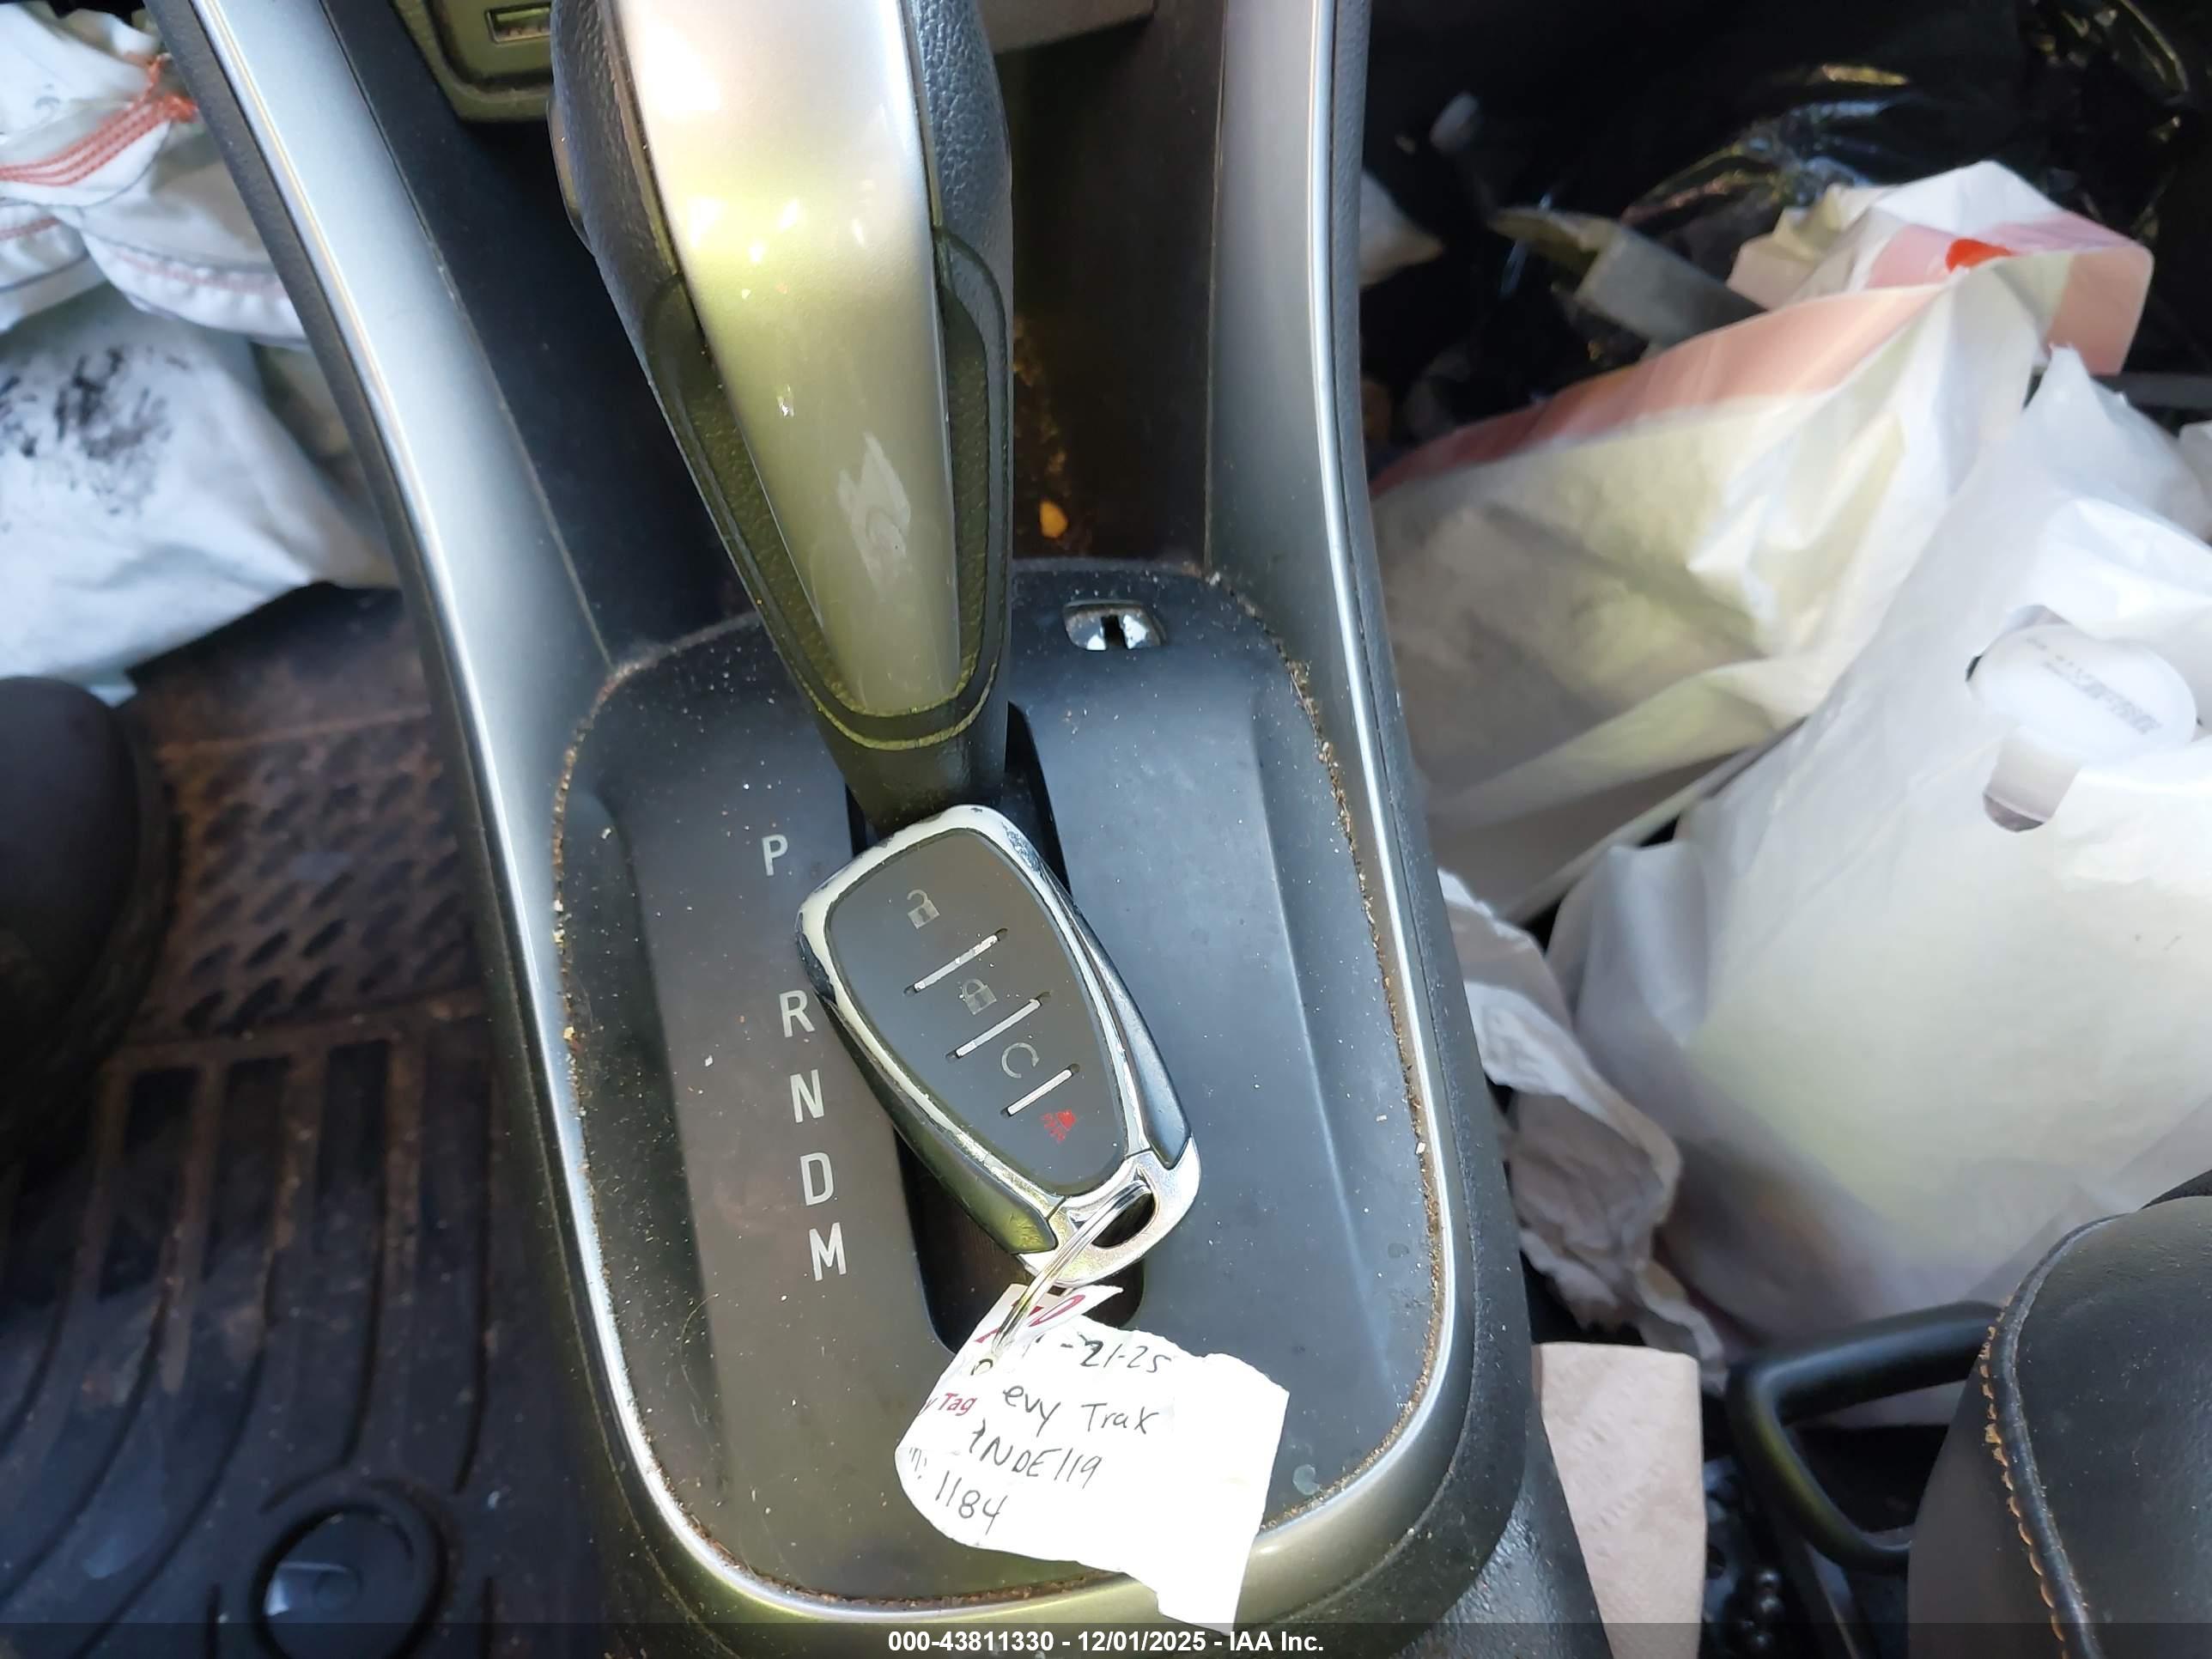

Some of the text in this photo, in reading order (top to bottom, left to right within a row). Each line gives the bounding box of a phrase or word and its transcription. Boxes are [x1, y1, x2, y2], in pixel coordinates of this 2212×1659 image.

[762, 834, 788, 876] P
[780, 990, 815, 1037] R
[790, 1069, 824, 1122] N
[799, 1152, 834, 1206] D
[809, 1222, 847, 1281] M
[938, 1392, 978, 1417] Tag
[935, 1469, 1008, 1535] 1184
